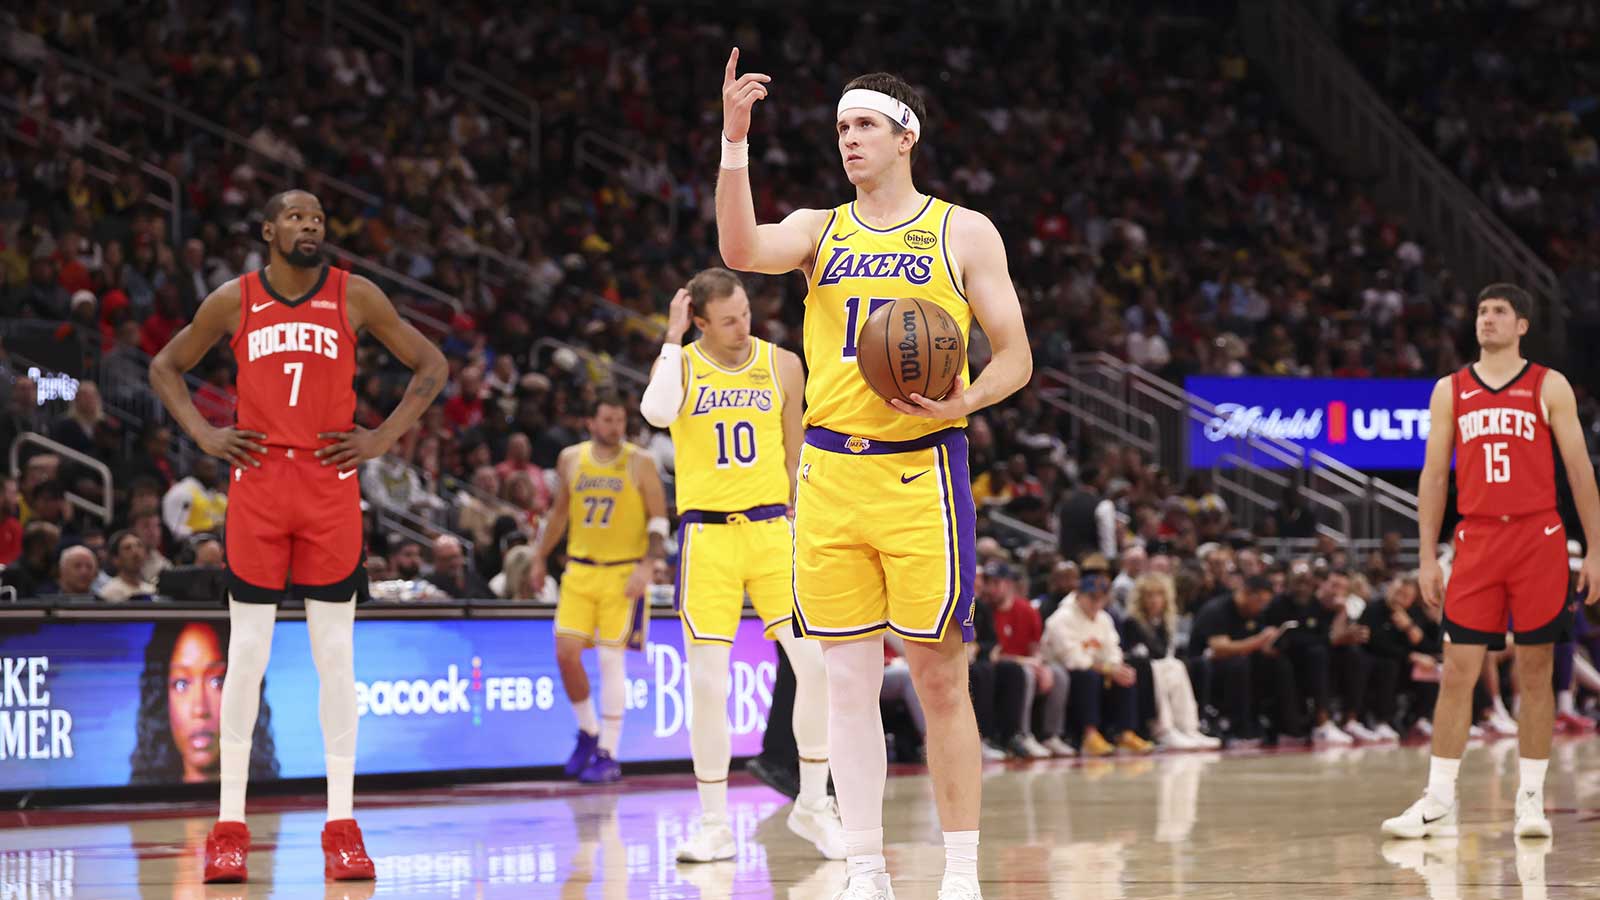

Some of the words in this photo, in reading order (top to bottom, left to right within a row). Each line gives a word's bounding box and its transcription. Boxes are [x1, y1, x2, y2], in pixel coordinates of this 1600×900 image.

[907, 234, 935, 245] bibigo
[817, 247, 934, 285] LAKERS
[247, 322, 339, 362] ROCKETS
[842, 297, 897, 358] 1
[899, 310, 922, 383] Wilson
[283, 362, 304, 407] 7
[690, 386, 772, 416] LAKERS
[714, 421, 757, 466] 10
[1458, 407, 1537, 444] ROCKETS
[1482, 442, 1511, 483] 15
[583, 496, 616, 526] 77
[0, 656, 50, 708] KE
[354, 664, 471, 716] eacock
[485, 677, 533, 711] FEB
[535, 676, 554, 710] 8
[646, 641, 777, 738] 'BBS
